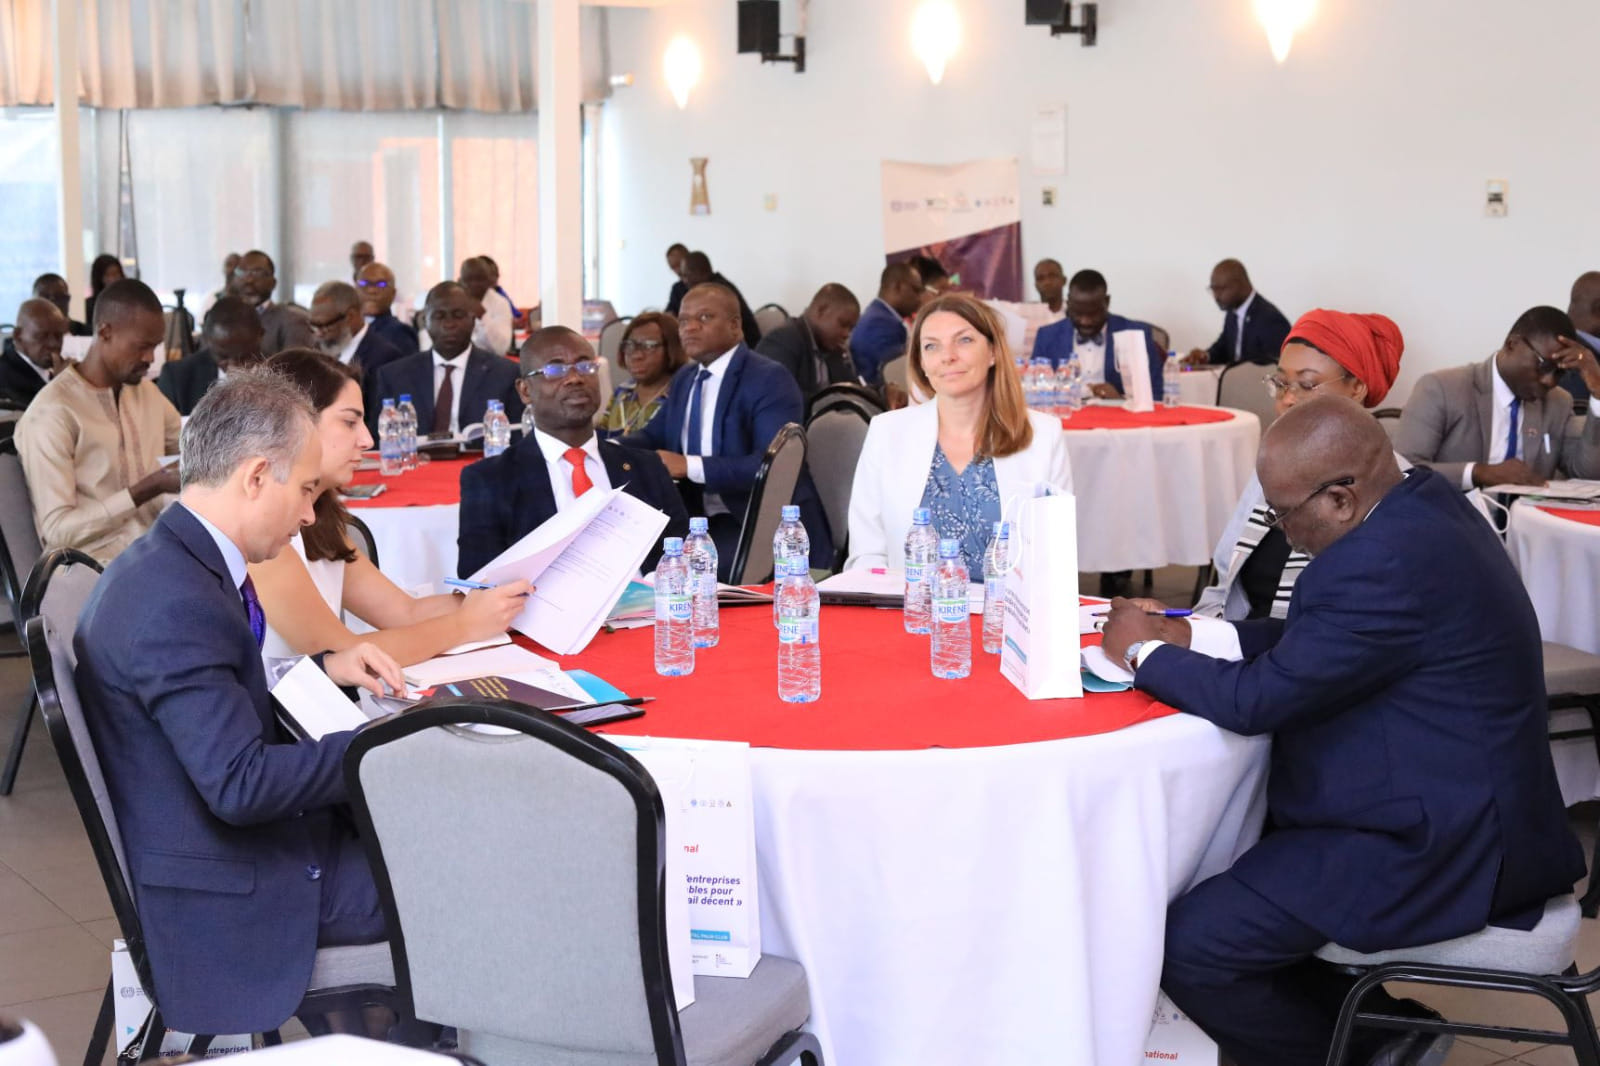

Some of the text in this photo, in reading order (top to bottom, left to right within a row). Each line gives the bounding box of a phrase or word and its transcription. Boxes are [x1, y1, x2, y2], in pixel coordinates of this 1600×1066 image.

[669, 602, 692, 611] KIREN
[684, 844, 699, 853] nal
[686, 874, 741, 885] 'entreprises
[687, 885, 733, 897] bles pour
[1144, 1050, 1178, 1061] national
